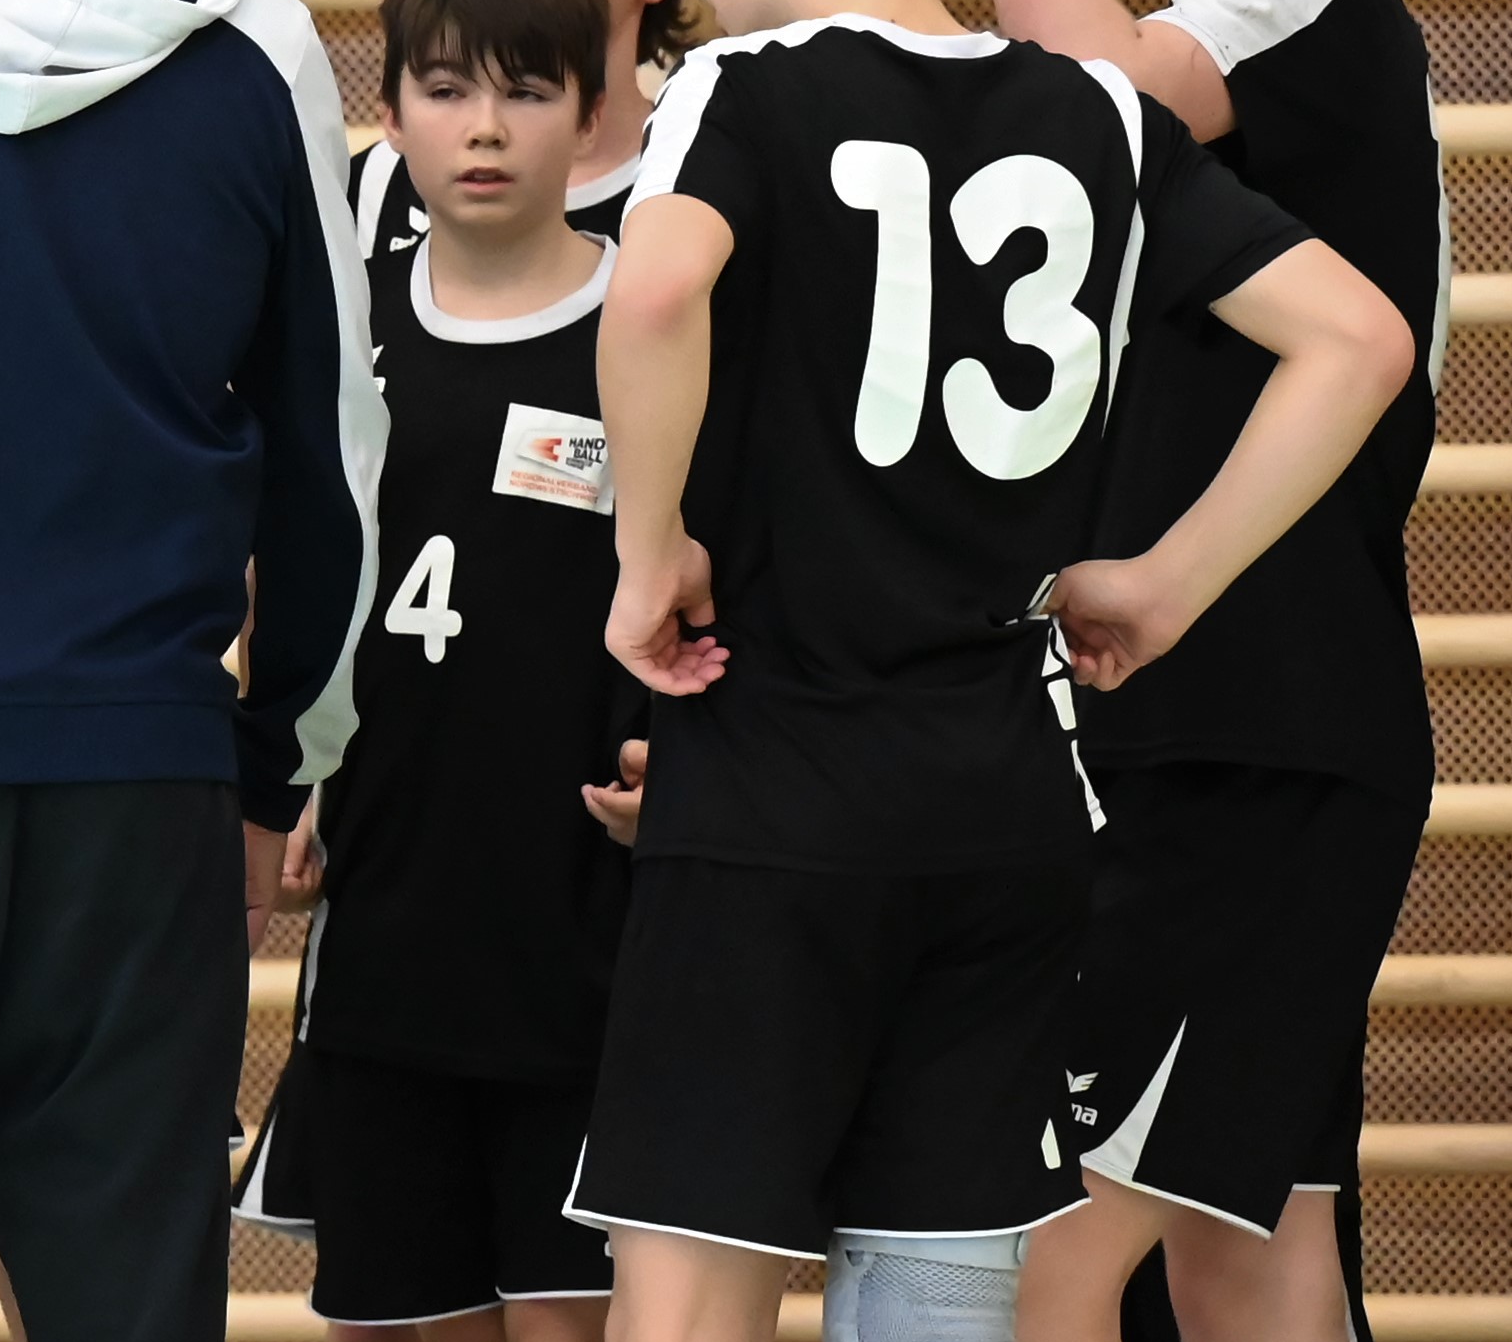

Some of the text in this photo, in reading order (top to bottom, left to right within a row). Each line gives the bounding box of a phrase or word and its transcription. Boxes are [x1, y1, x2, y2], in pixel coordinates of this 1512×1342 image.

[830, 139, 1102, 481] 13
[568, 437, 606, 451] HAND
[573, 448, 604, 465] BALL
[384, 534, 463, 664] 4
